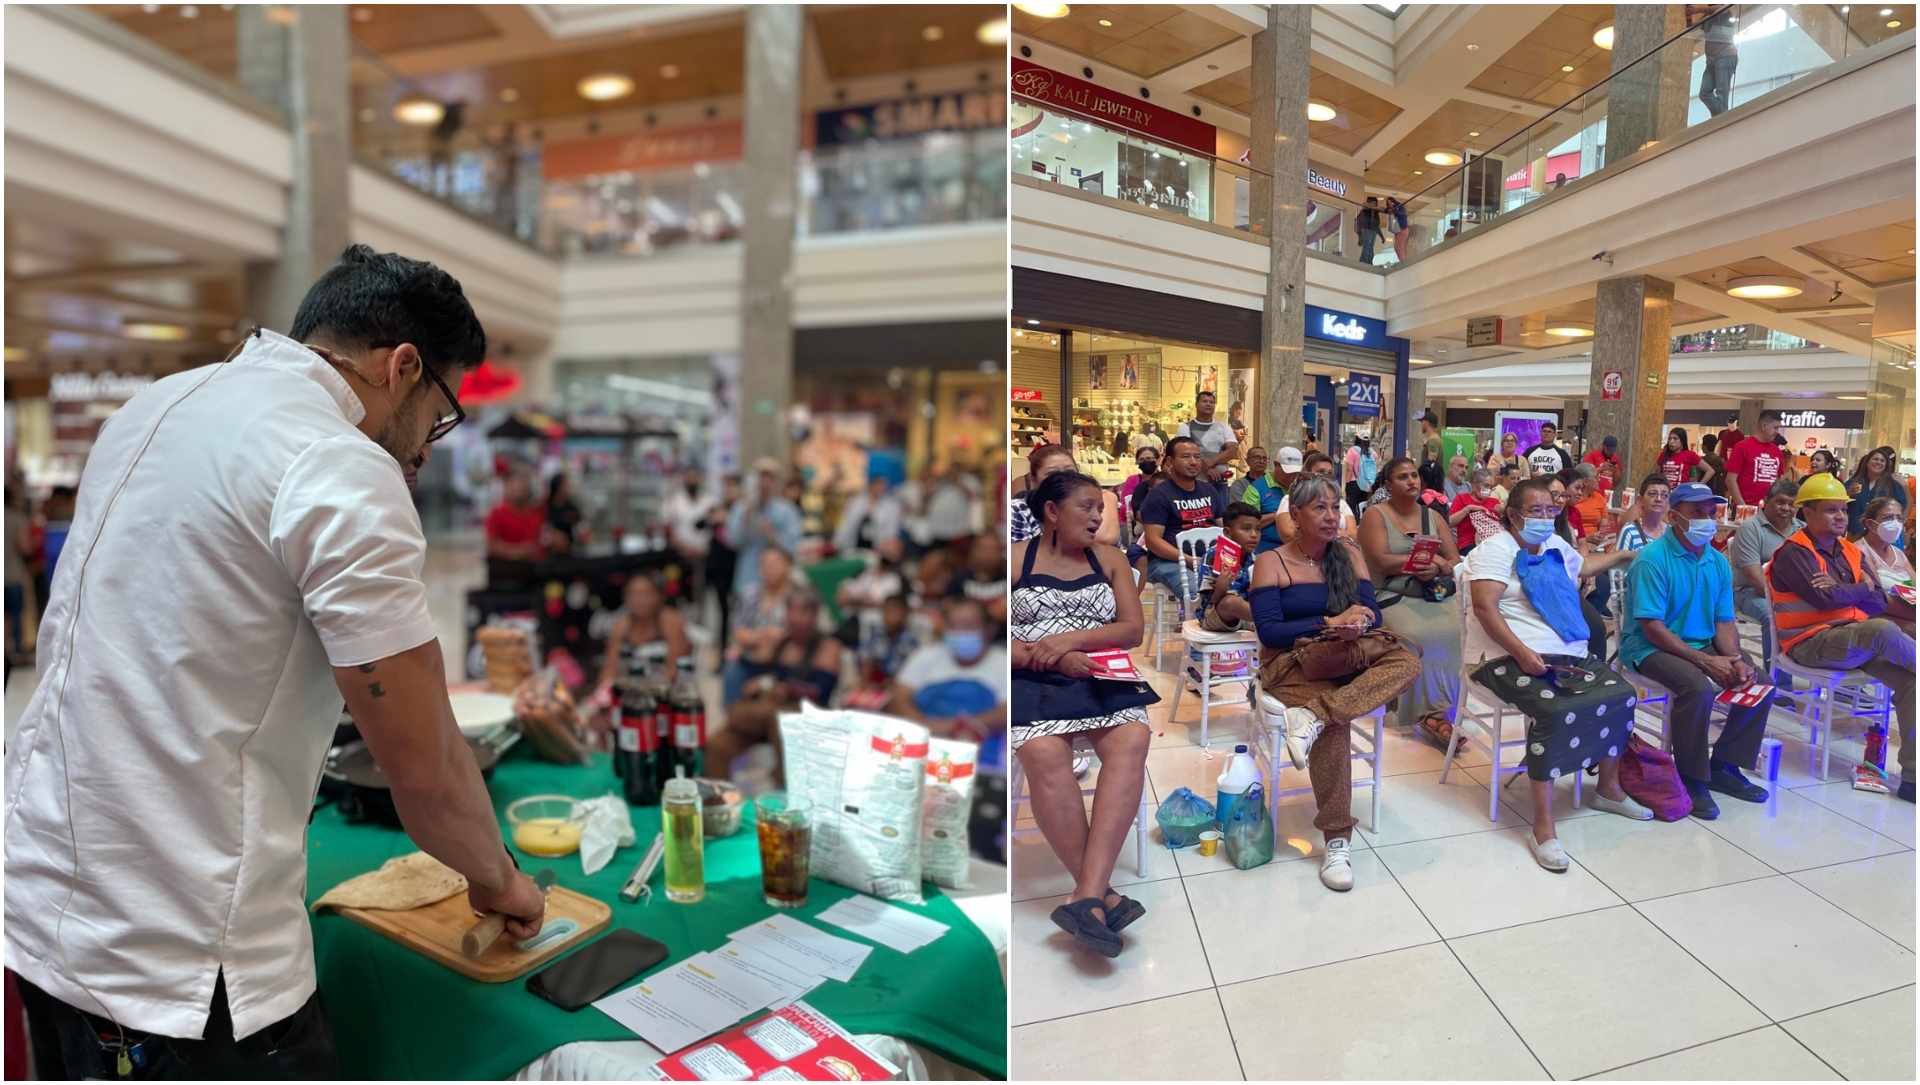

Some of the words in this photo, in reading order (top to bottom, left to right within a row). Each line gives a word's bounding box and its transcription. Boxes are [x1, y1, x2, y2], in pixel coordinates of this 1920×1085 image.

[1090, 97, 1152, 127] JEWELRY
[1307, 168, 1346, 197] Beauty
[1322, 313, 1365, 340] Keds
[1350, 382, 1379, 403] 2X1
[1780, 410, 1826, 427] traffic
[1174, 496, 1212, 511] TOMMY
